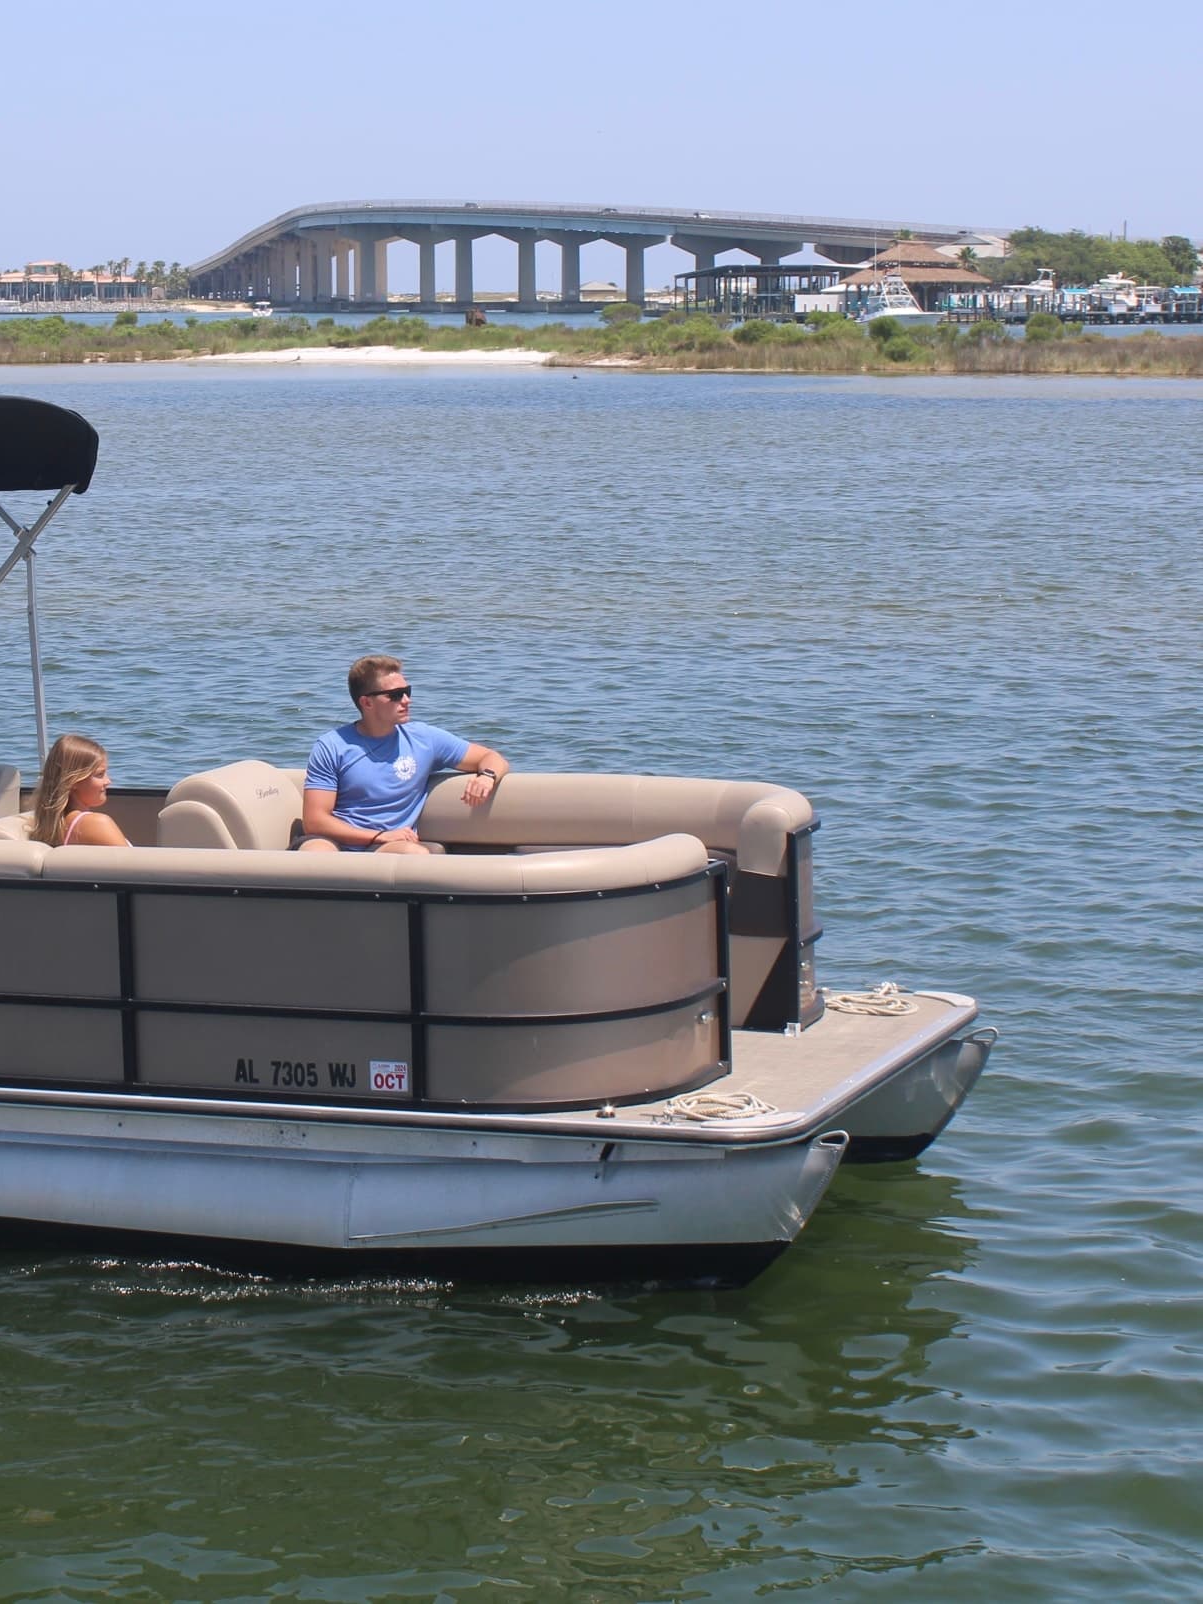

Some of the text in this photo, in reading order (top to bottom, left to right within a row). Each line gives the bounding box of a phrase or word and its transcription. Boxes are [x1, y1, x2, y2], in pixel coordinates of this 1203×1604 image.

[235, 1058, 357, 1088] AL 7305 WJ
[374, 1073, 405, 1090] OCT
